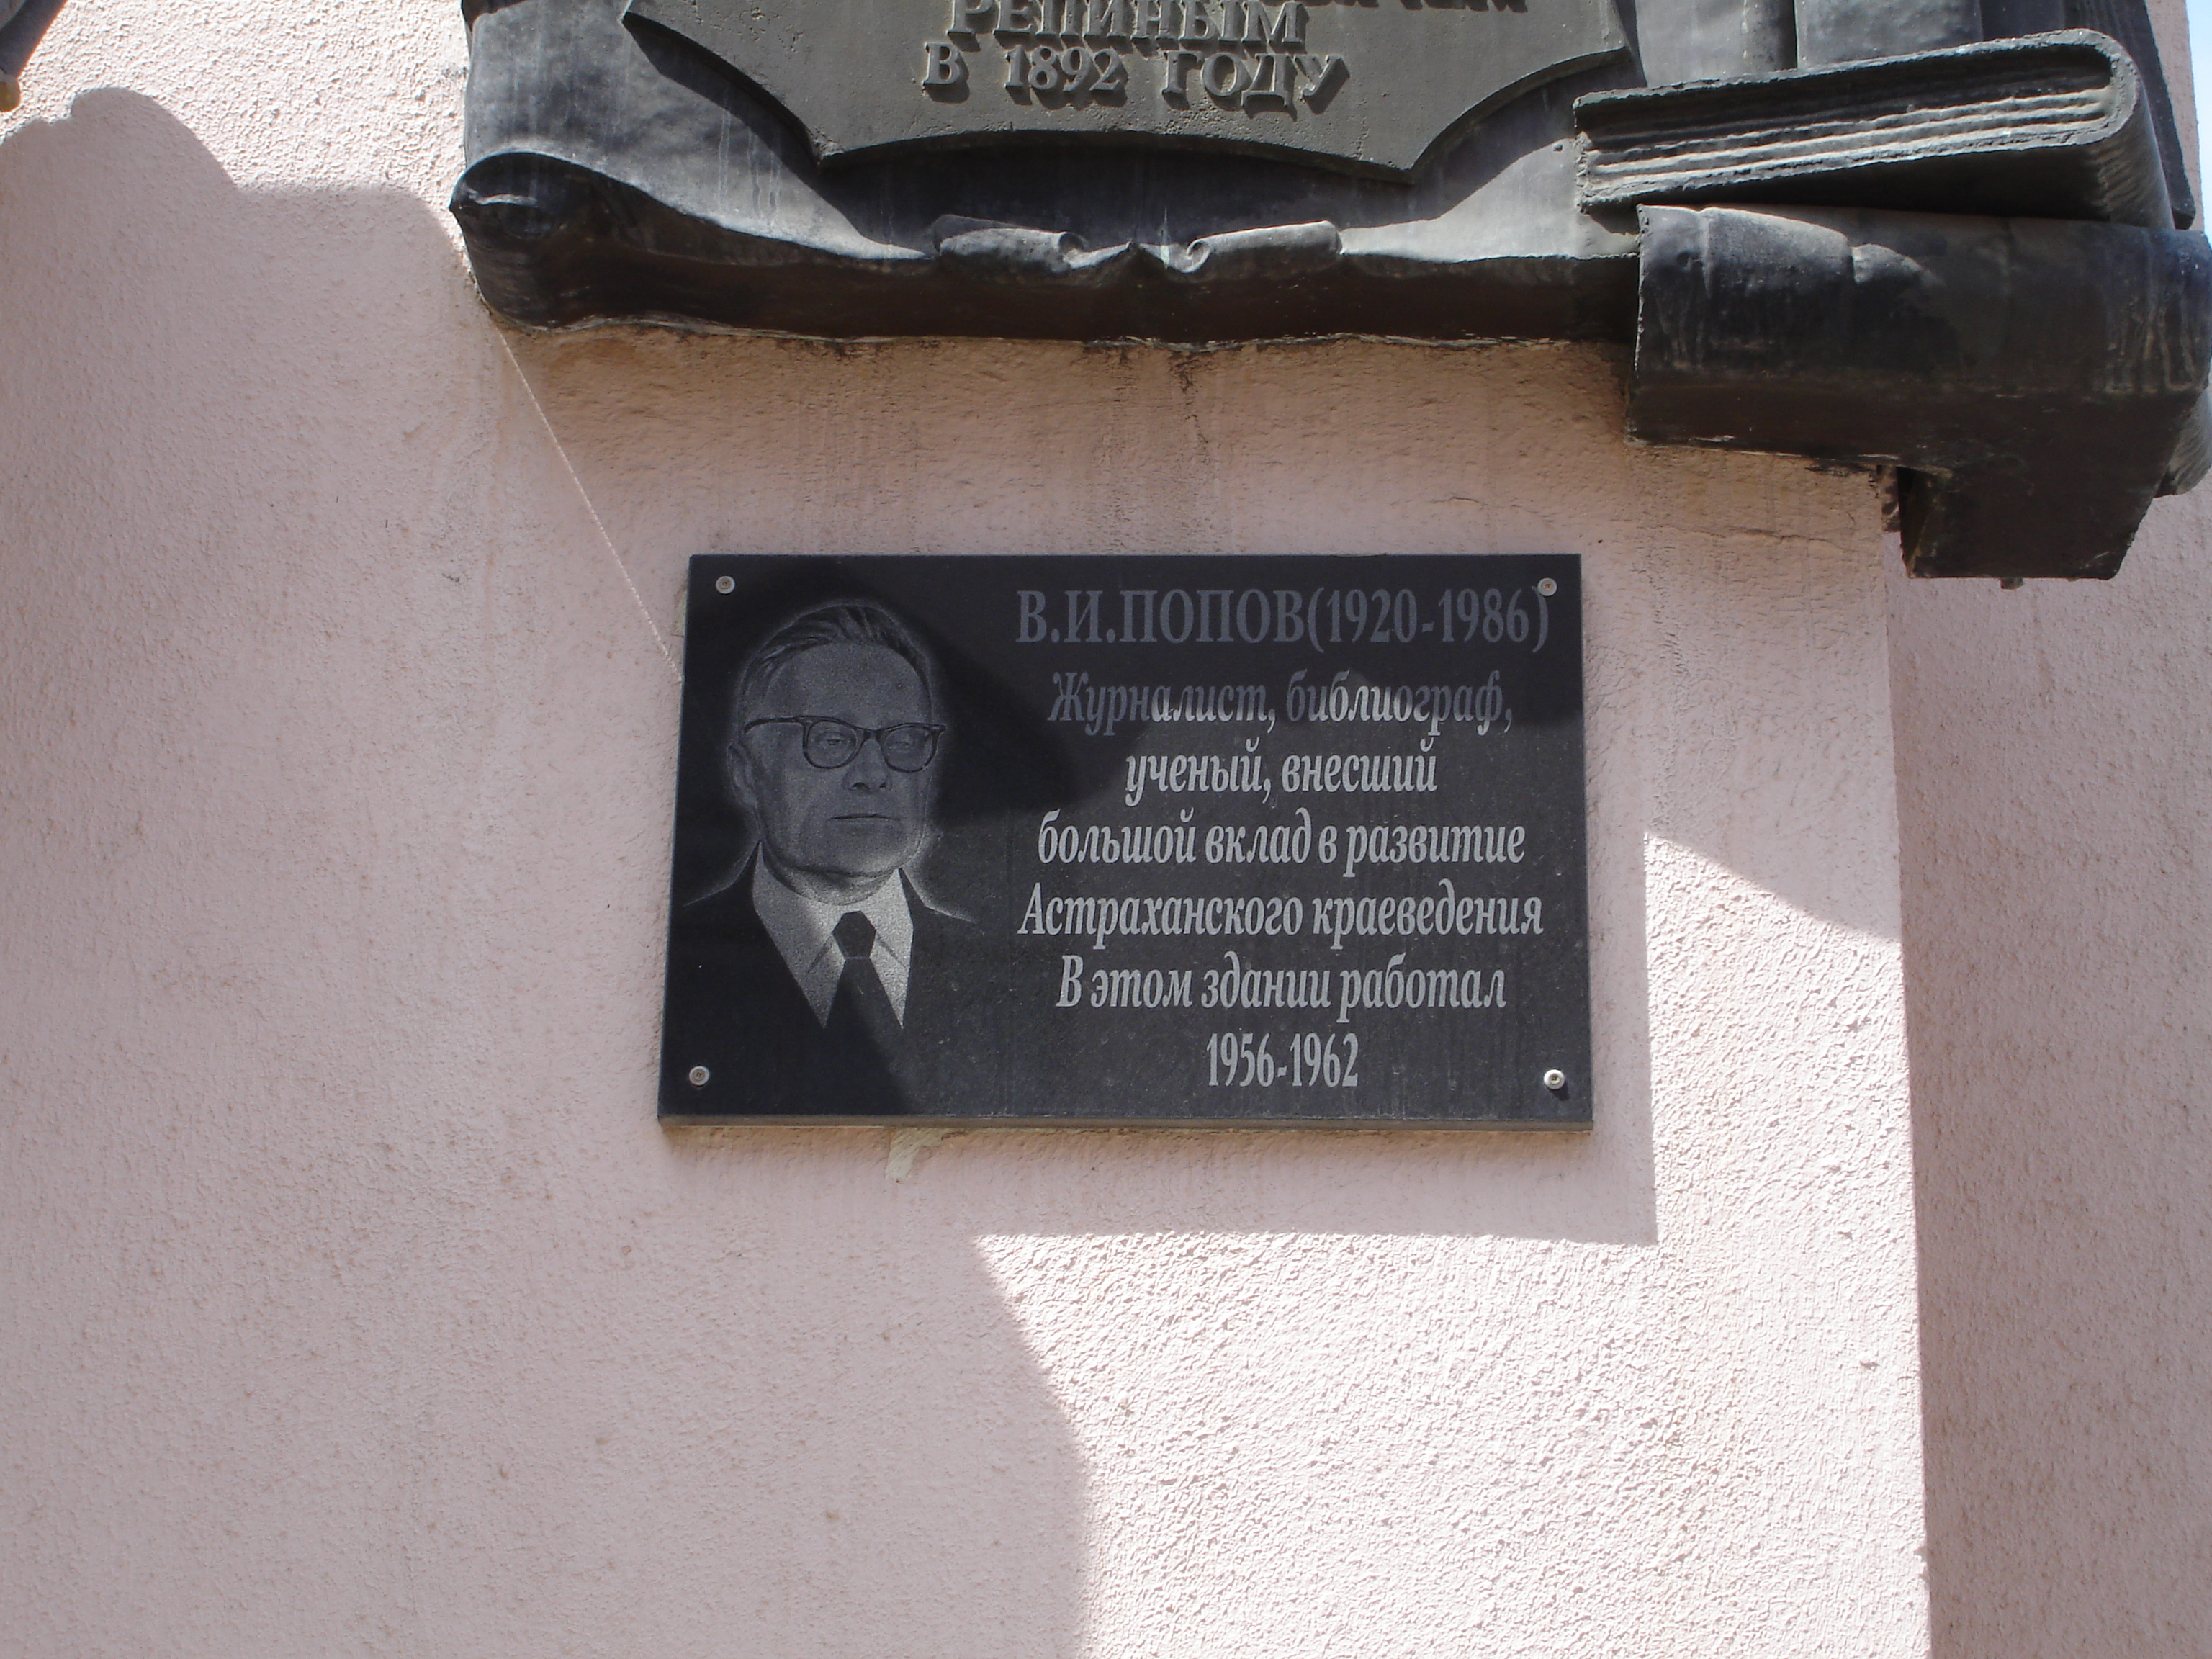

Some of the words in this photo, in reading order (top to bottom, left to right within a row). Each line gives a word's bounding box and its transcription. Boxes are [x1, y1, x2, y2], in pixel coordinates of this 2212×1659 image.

[922, 42, 963, 87] В
[1005, 45, 1125, 93] 1892
[1163, 50, 1342, 106] ГОДУ
[1047, 672, 1276, 736] Журналист,
[1287, 670, 1512, 737] библиограф,
[1125, 738, 1272, 806] ученый,
[1282, 738, 1438, 793] внесший
[1038, 807, 1195, 863] большой
[1205, 807, 1311, 863] вклад
[1318, 826, 1337, 863] в
[1343, 824, 1526, 878] развитие
[1017, 882, 1303, 950] Астраханского
[1312, 878, 1544, 950] краеведения
[1056, 955, 1083, 1007] В
[1091, 968, 1192, 1007] этом
[1202, 951, 1331, 1007] здании
[1337, 953, 1506, 1022] работал
[1206, 1032, 1359, 1087] 1956-1962
